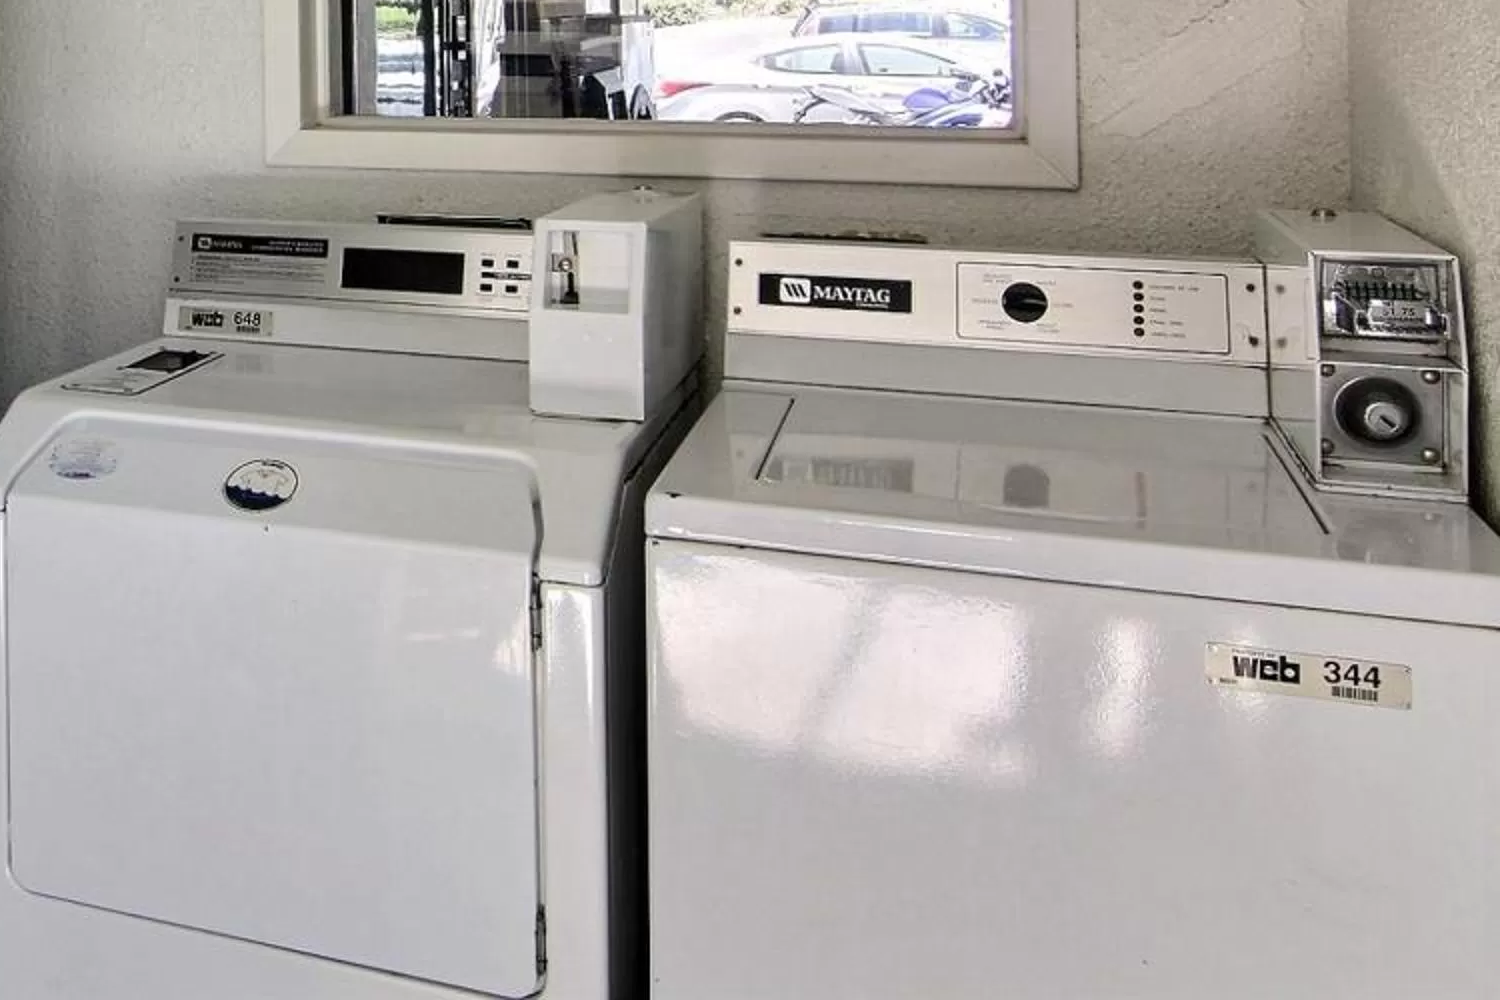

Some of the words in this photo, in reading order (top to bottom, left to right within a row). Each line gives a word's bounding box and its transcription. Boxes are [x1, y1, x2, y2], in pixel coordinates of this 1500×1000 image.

[813, 285, 890, 303] MAYTAG
[234, 311, 261, 327] 648
[1323, 660, 1381, 689] 344
